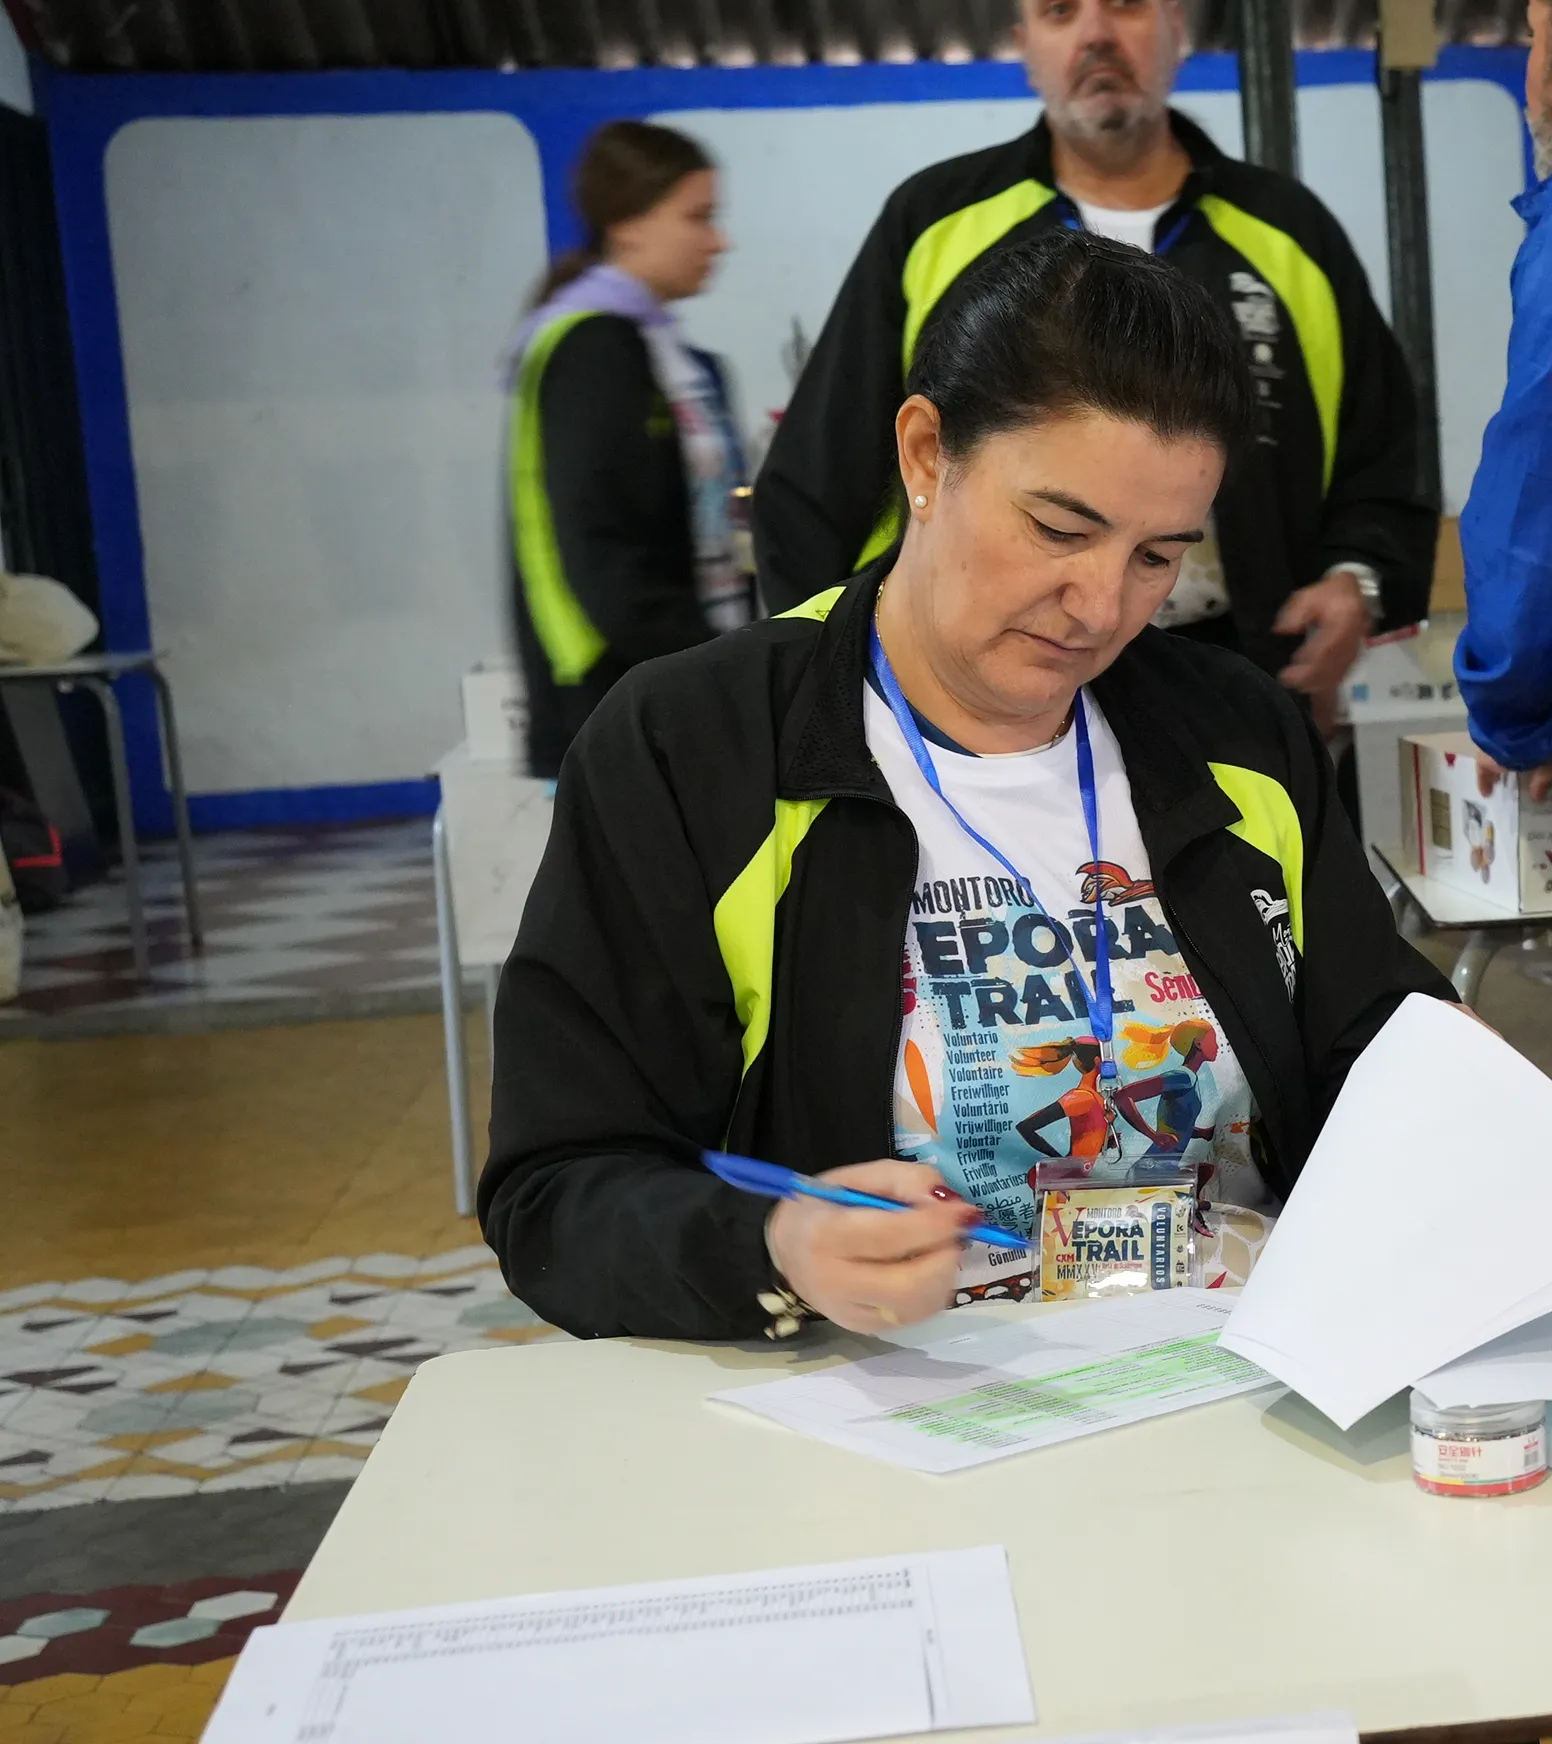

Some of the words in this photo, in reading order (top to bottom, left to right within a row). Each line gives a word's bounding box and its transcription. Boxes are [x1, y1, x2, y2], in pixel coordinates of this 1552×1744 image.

[912, 876, 1035, 914] MONTORO
[912, 905, 1180, 979] EPORA
[943, 1031, 999, 1047] Voluntario
[946, 1049, 997, 1065] Volunteer
[949, 1066, 1003, 1083] Volontaire
[951, 1083, 1010, 1101] Freiwilliger
[953, 1101, 1009, 1118] Voluntário
[955, 1118, 1013, 1134] Vrijwilliger
[957, 1149, 995, 1166] Frivillig
[963, 1163, 998, 1182] Frivillig
[968, 1172, 1029, 1198] Wolontariusz
[1086, 1207, 1122, 1219] MONTORO
[1072, 1219, 1145, 1240] EPORA
[1072, 1240, 1145, 1262] TRAIL
[1155, 1206, 1167, 1284] VOLUNTARIOS
[1055, 1253, 1075, 1263] CXM
